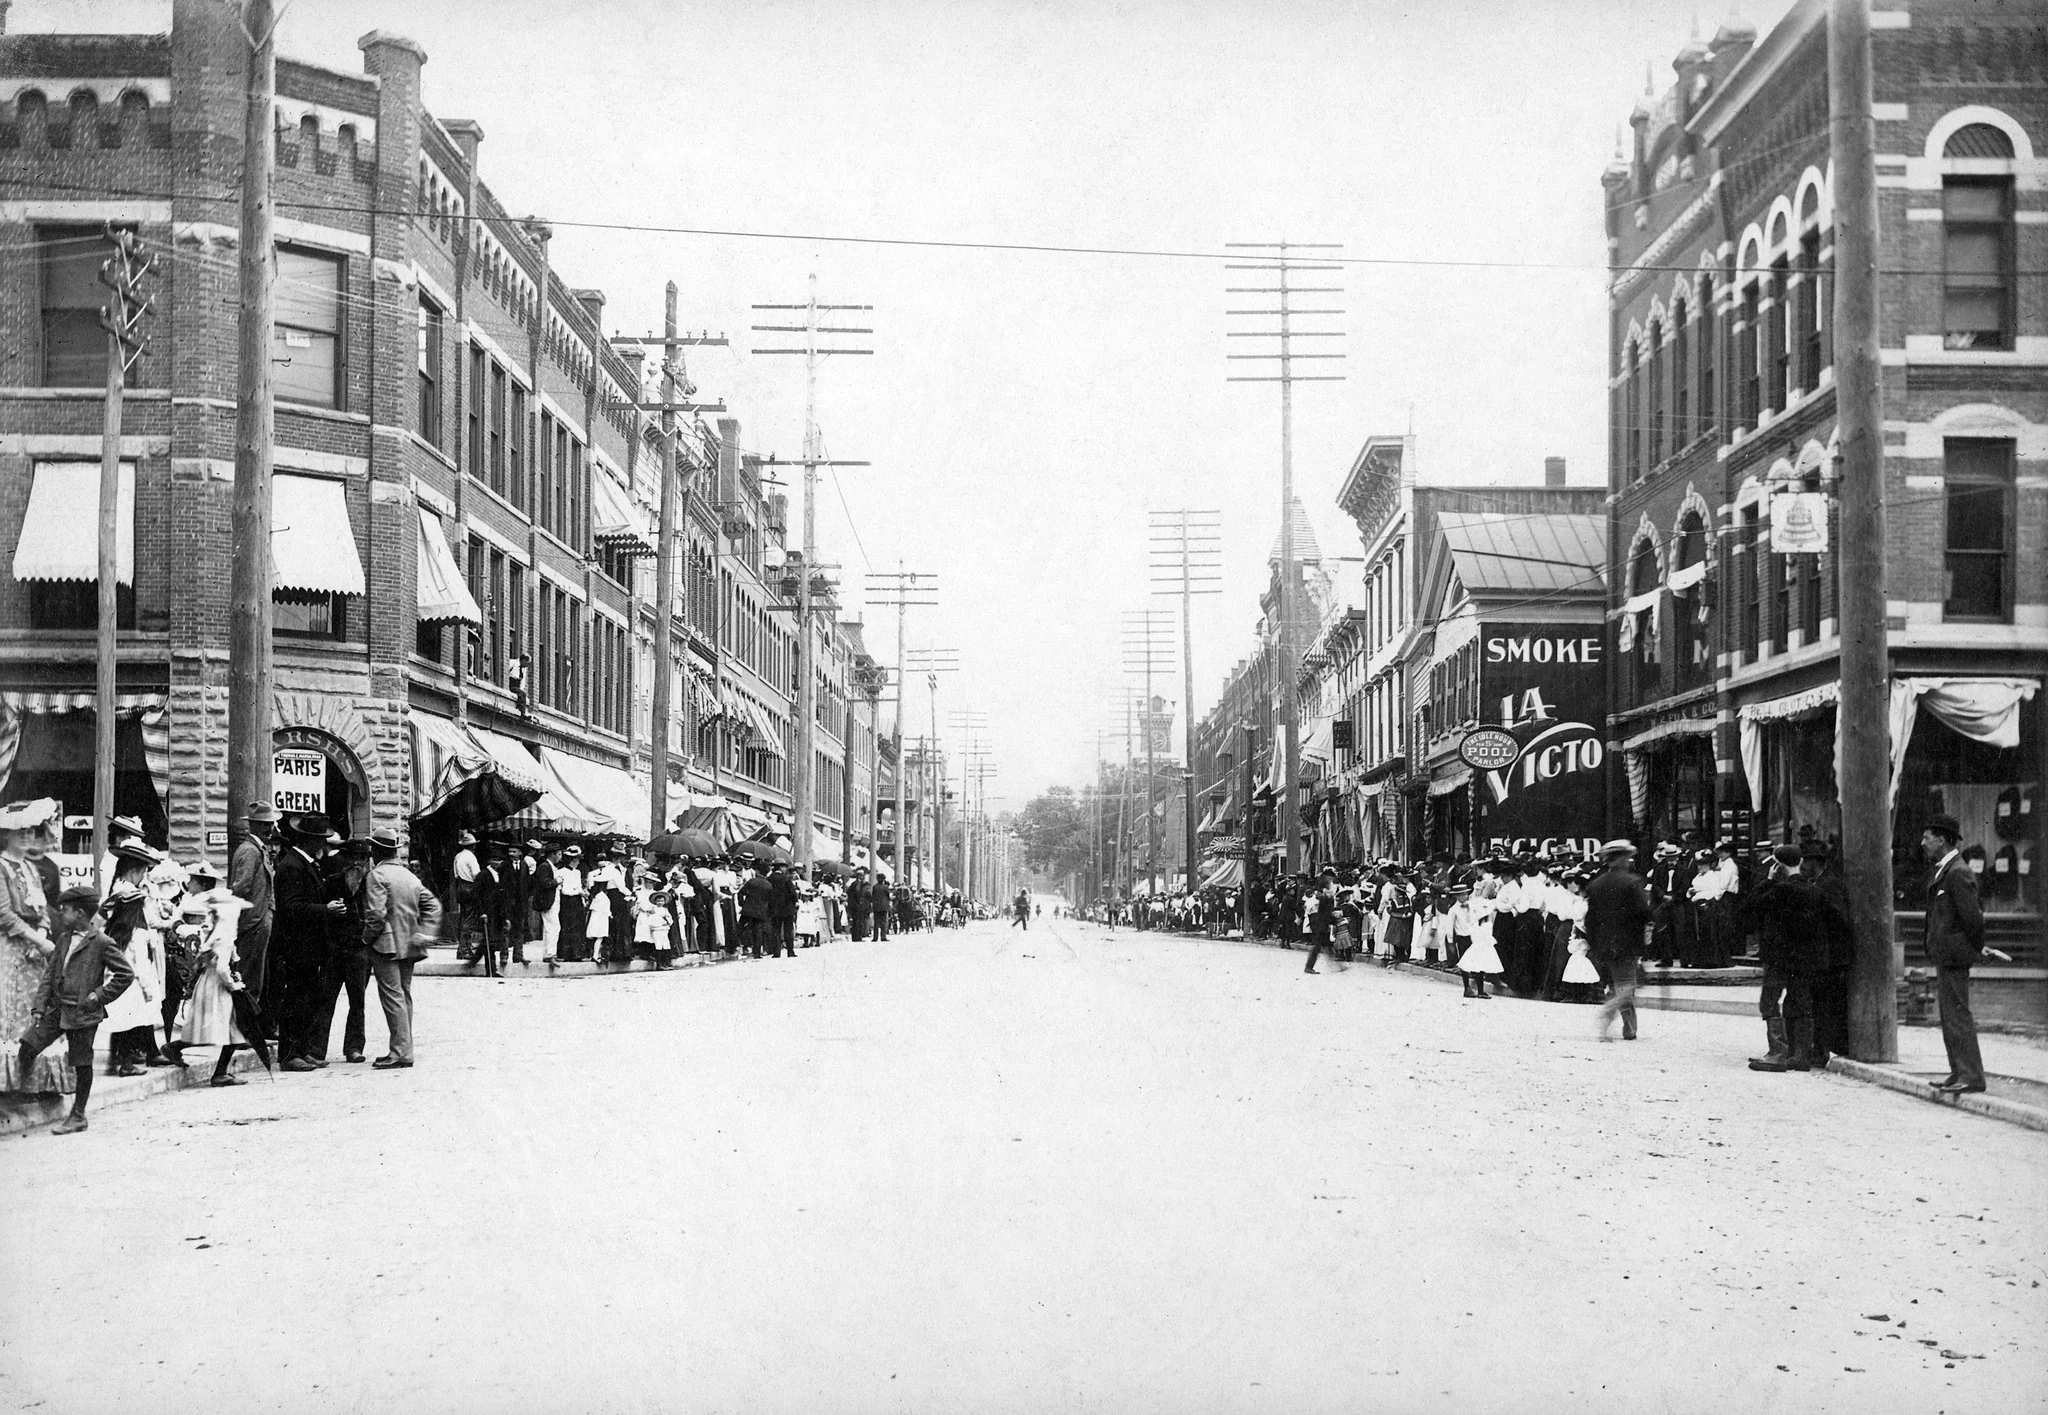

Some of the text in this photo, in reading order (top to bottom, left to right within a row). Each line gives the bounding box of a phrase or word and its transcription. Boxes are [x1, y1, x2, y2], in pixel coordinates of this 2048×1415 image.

[1487, 638, 1601, 663] SMOKE
[1501, 686, 1558, 731] LA
[1692, 706, 1698, 718] &
[1467, 733, 1512, 746] THE IDLE HOUR
[1467, 747, 1512, 757] POOL
[274, 757, 321, 776] PARIS
[1473, 756, 1505, 766] PARLOR
[274, 791, 321, 811] GREEN
